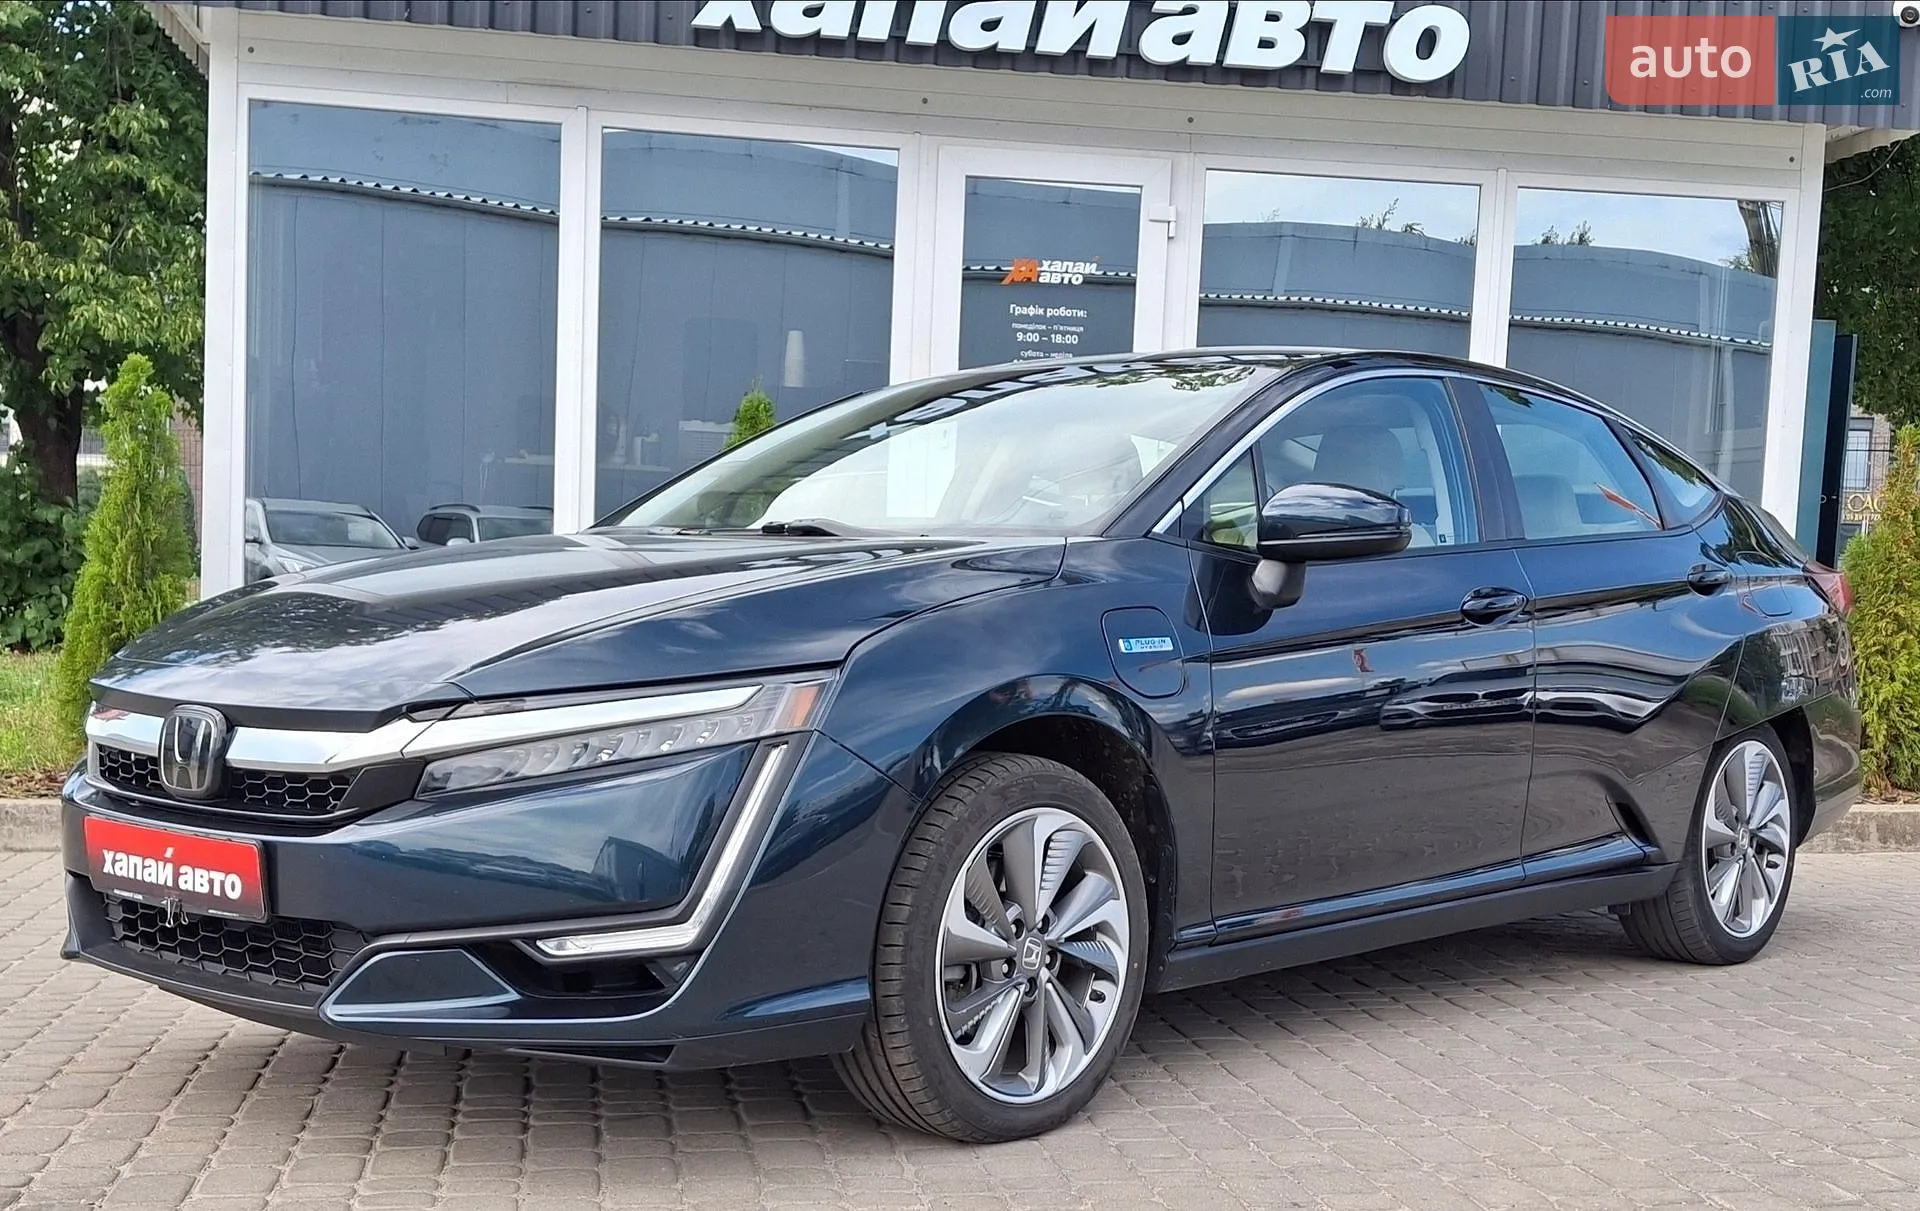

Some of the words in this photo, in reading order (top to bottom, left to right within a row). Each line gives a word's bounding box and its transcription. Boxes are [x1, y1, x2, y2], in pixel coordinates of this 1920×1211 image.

[1138, 1, 1472, 84] авто
[1038, 272, 1084, 285] авто
[1009, 303, 1045, 317] Графік
[1046, 306, 1087, 318] роботи:
[1016, 332, 1040, 343] 9:00
[1050, 334, 1079, 344] 18:00
[102, 847, 175, 887] хапай
[177, 864, 243, 900] авто
